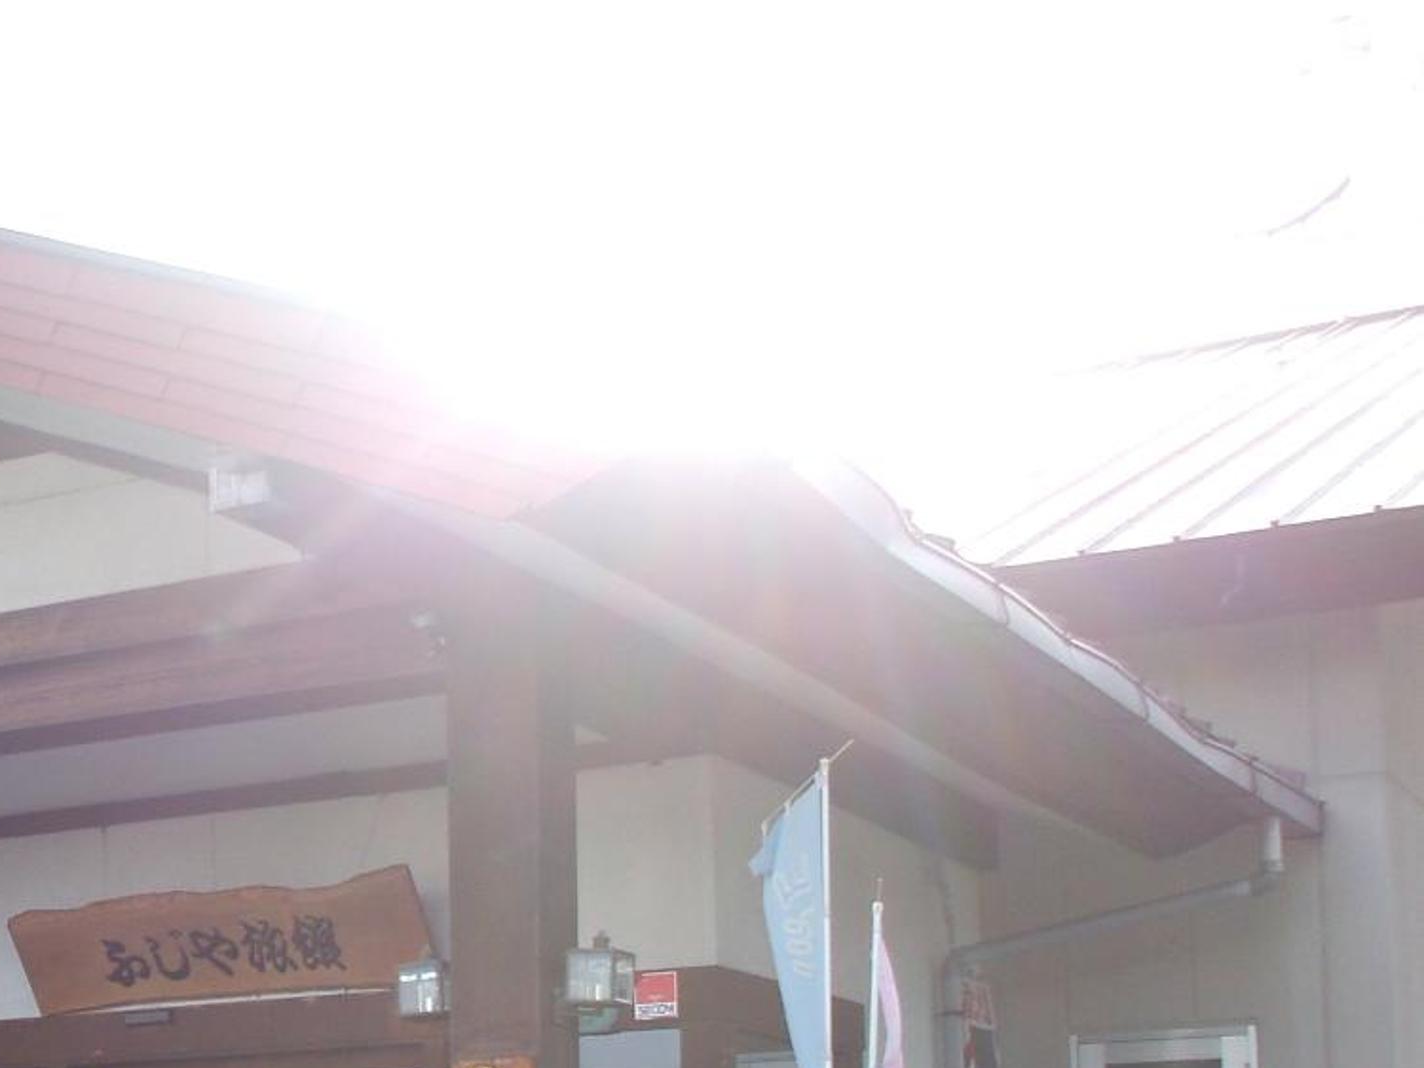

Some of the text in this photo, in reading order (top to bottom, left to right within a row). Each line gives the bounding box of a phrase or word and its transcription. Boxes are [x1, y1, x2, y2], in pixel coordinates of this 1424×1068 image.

[99, 915, 346, 987] ふじや旅館
